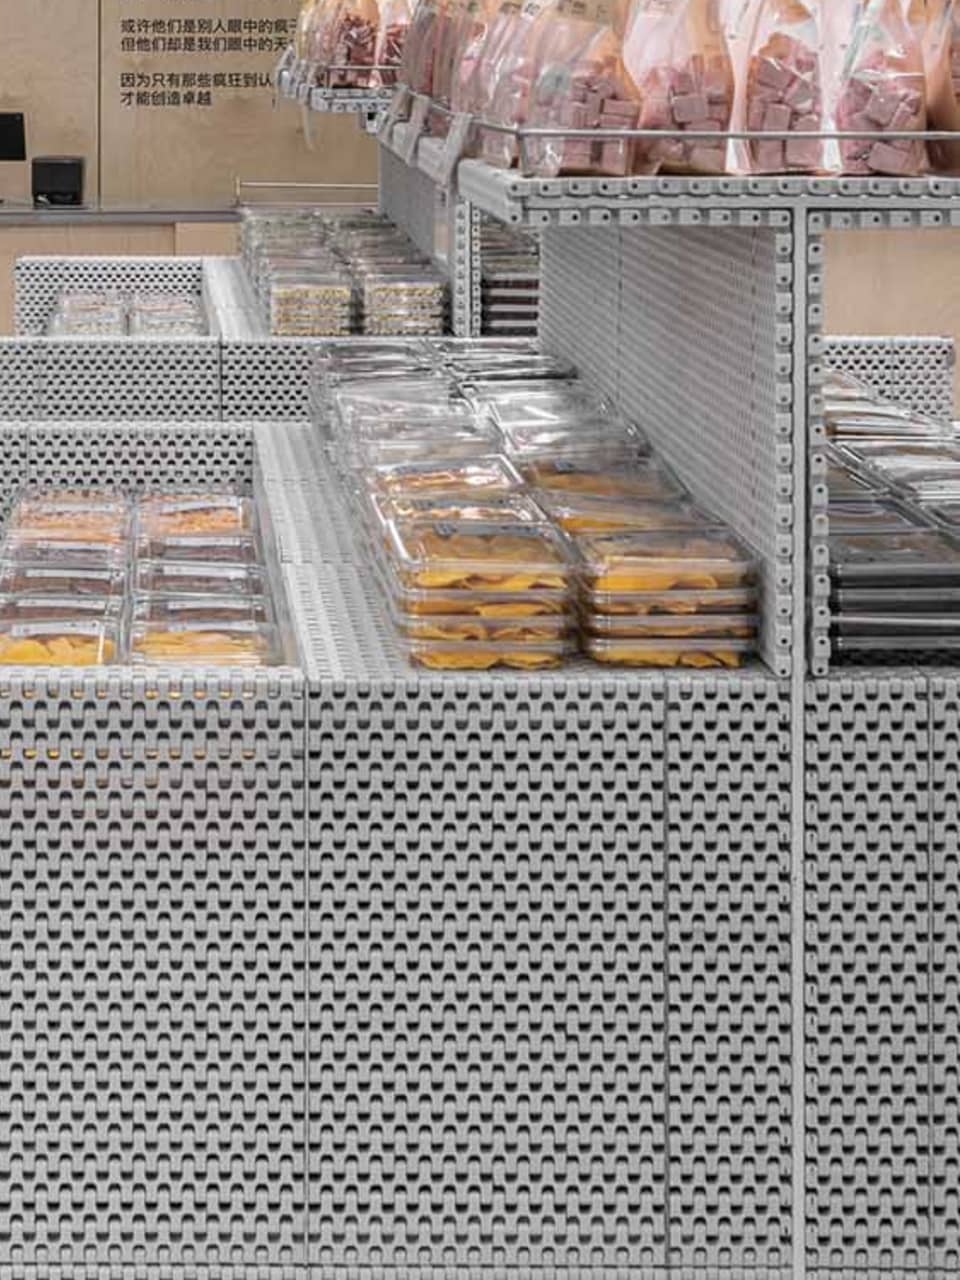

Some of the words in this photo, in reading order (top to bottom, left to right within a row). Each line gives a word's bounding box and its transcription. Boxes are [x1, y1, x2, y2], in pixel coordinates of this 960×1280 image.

[120, 91, 212, 106] 才能创造卓越
